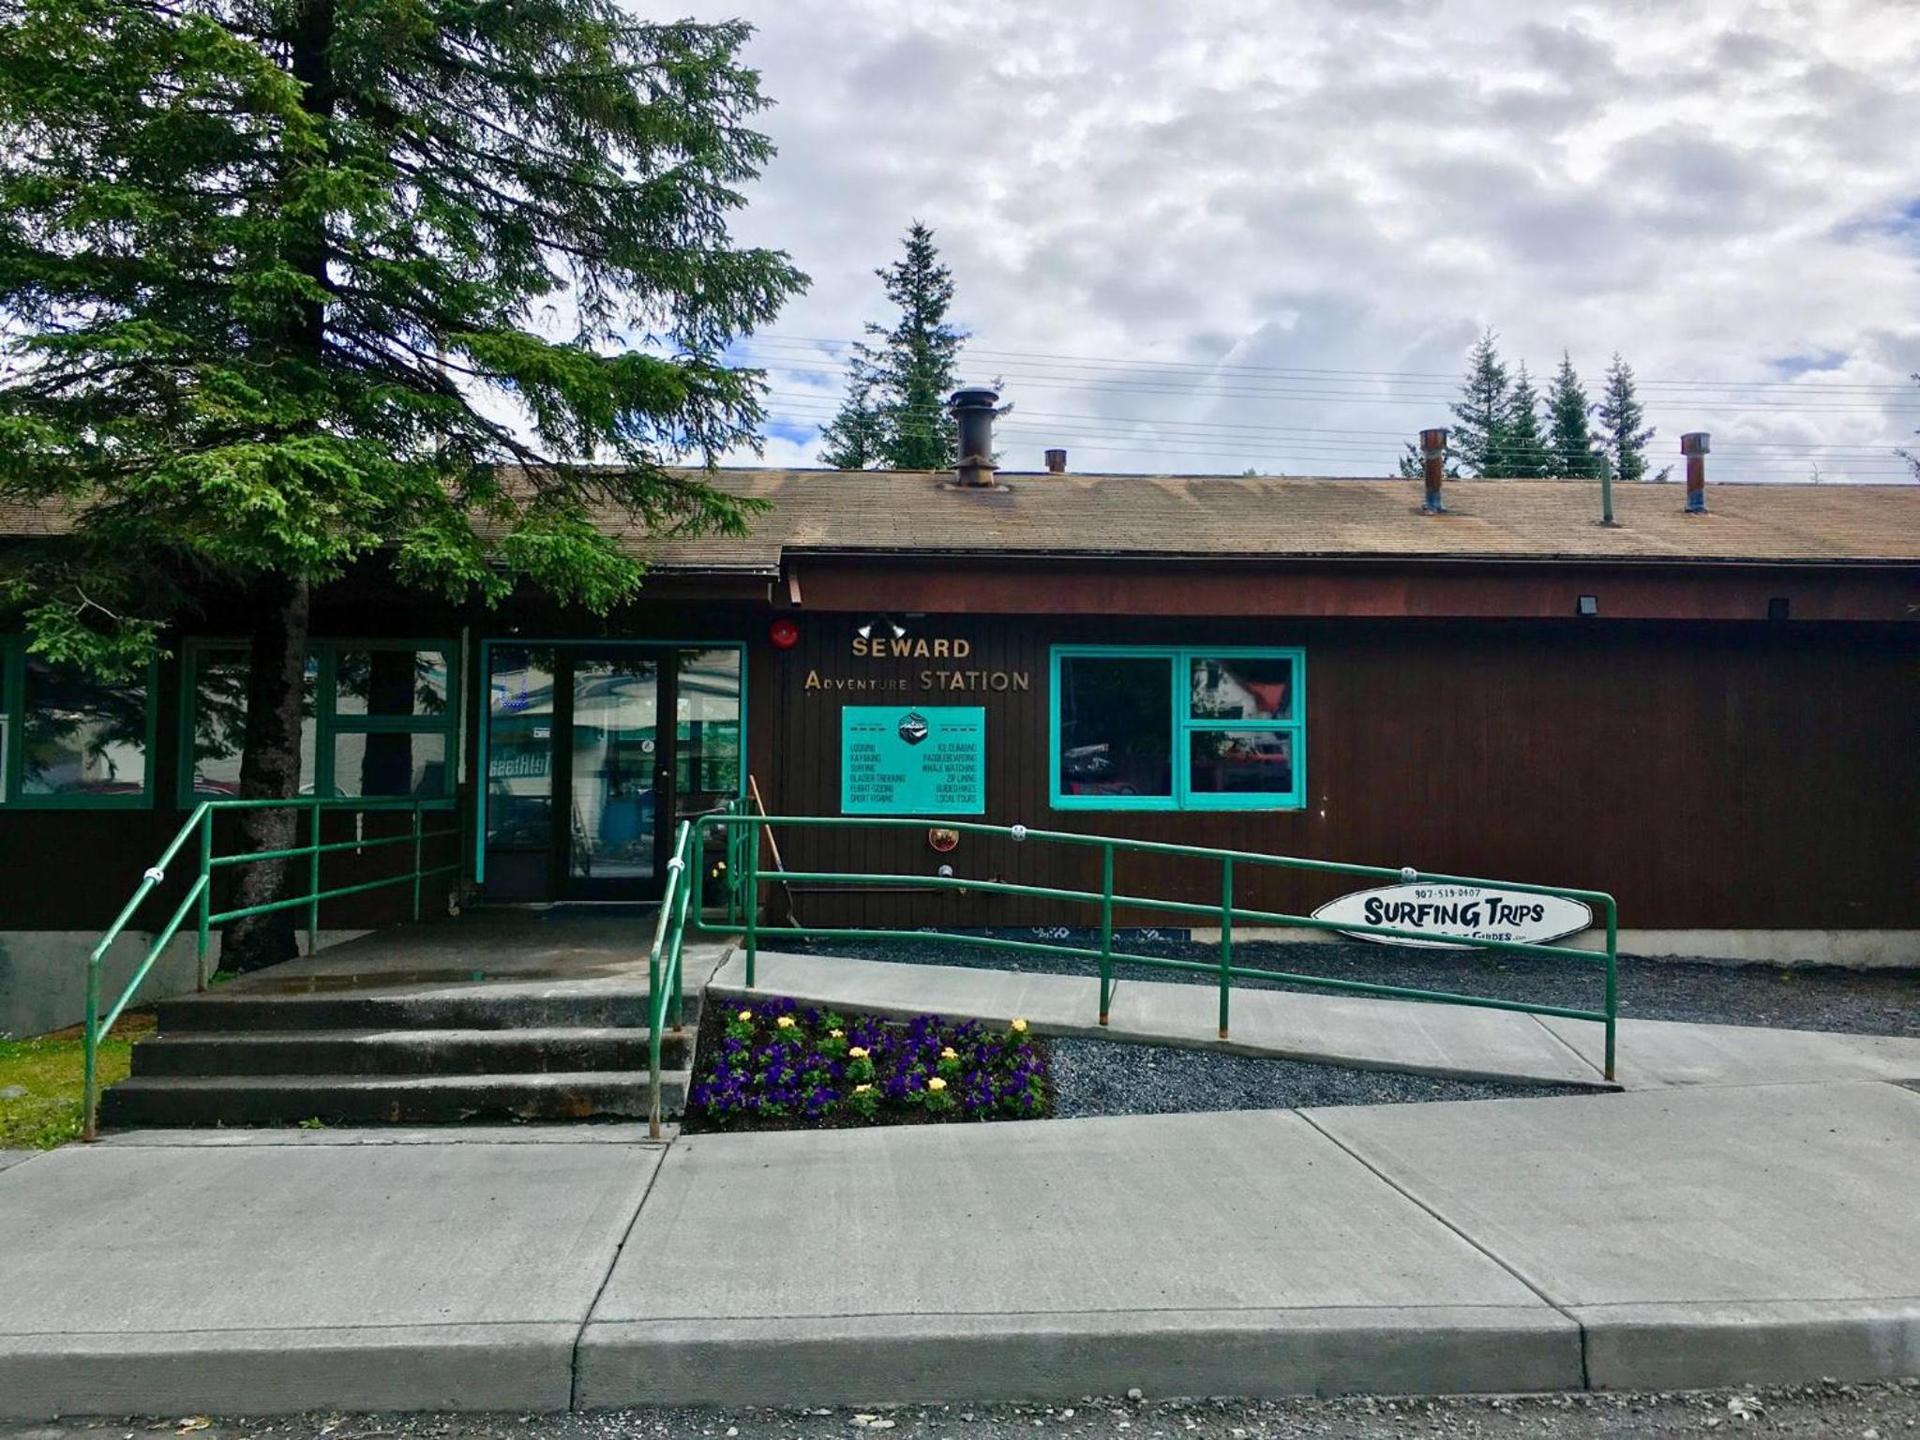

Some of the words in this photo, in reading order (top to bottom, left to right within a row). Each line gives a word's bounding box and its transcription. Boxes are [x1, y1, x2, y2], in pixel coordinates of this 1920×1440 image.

[852, 638, 970, 657] SEWARD
[920, 671, 1029, 691] STATION
[1364, 897, 1481, 928] SURFING
[1485, 897, 1545, 927] TRIPS
